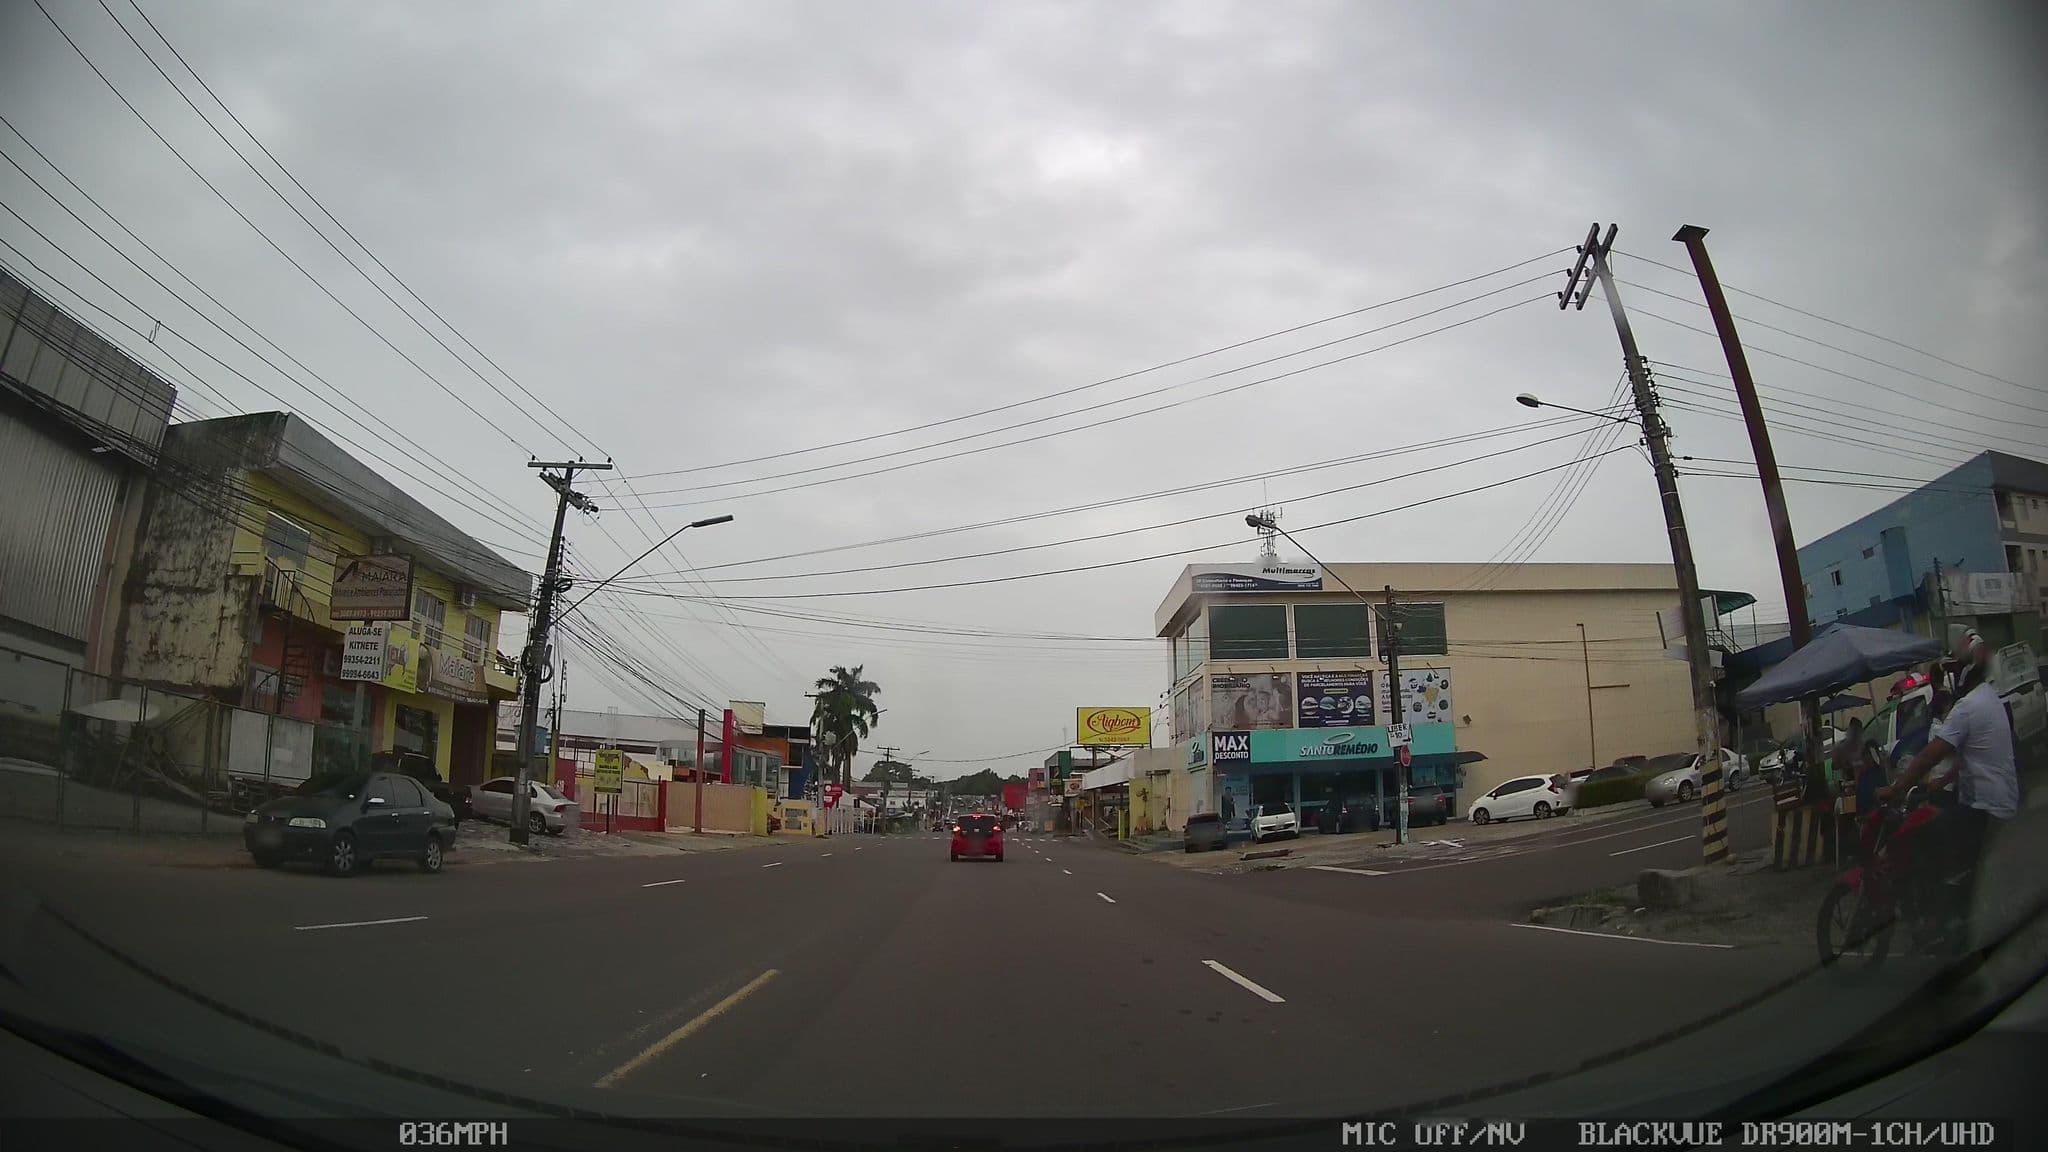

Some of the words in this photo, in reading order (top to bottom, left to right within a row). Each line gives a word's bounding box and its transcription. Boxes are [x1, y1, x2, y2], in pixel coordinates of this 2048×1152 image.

[1262, 567, 1316, 576] Multimarcas
[349, 627, 383, 636] ALUGA-SE
[349, 641, 379, 650] KITNETE
[343, 654, 380, 665] 99354-2211
[1214, 735, 1248, 751] MAX
[1214, 751, 1249, 760] DESCONTO
